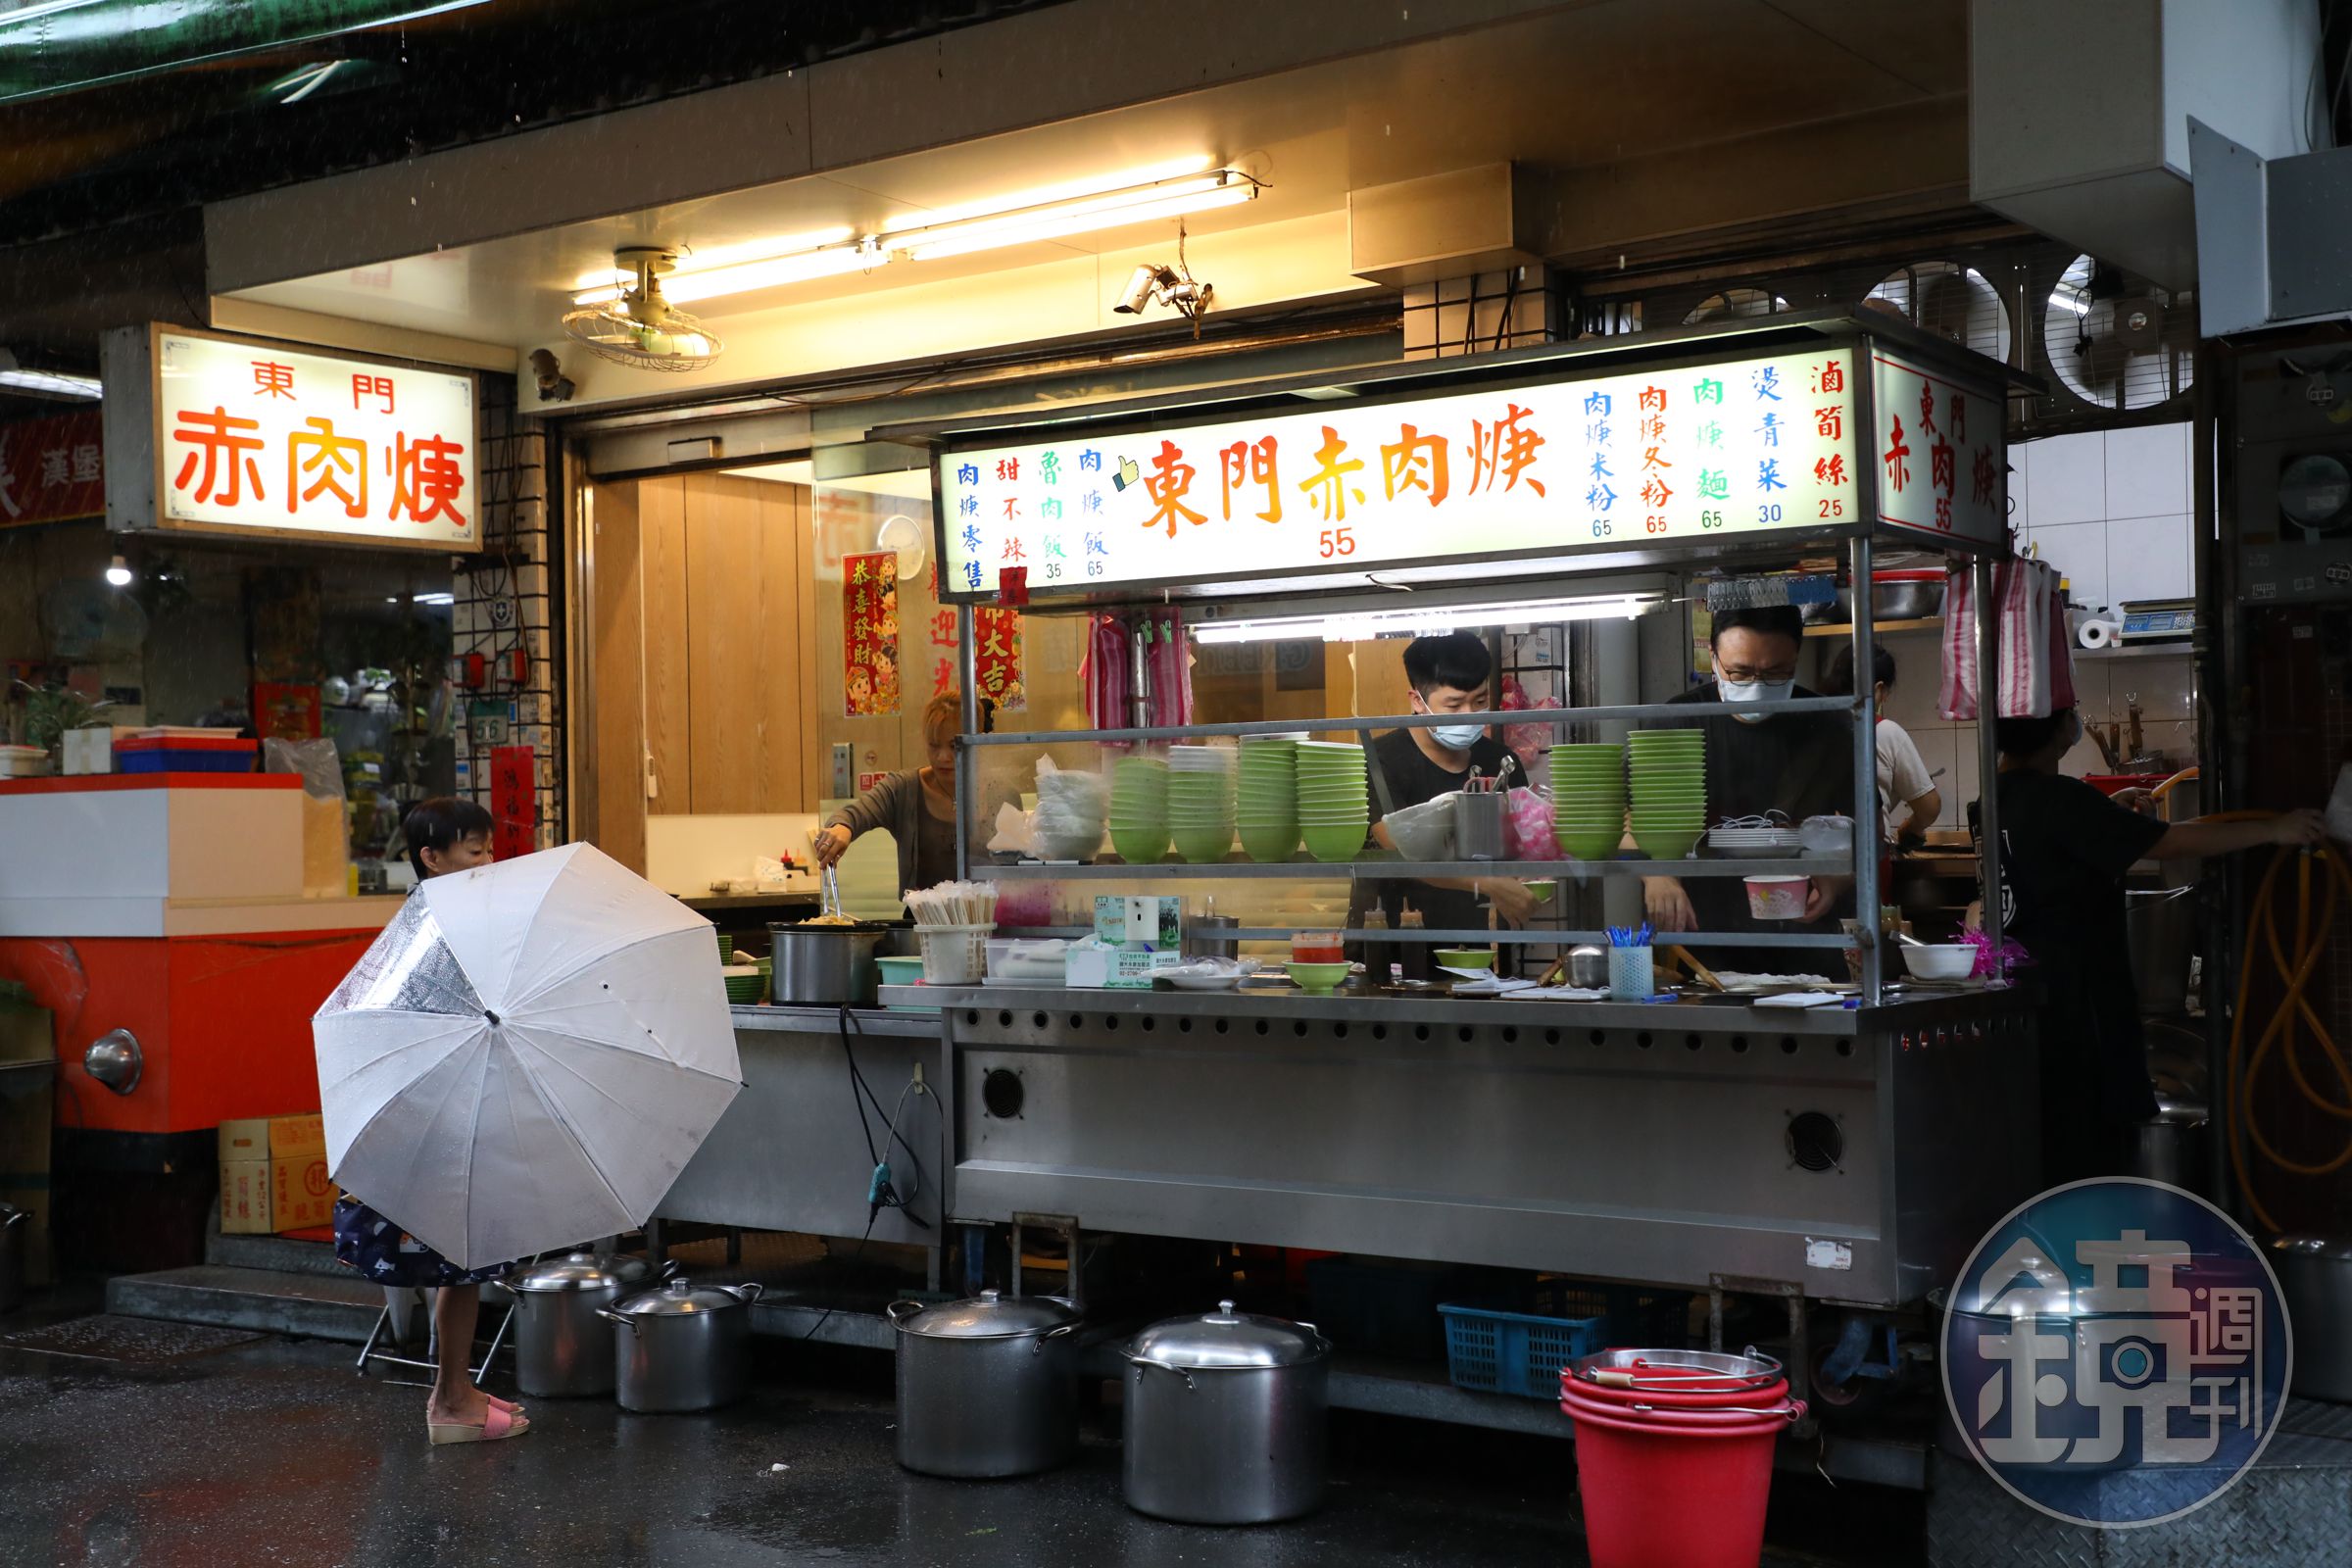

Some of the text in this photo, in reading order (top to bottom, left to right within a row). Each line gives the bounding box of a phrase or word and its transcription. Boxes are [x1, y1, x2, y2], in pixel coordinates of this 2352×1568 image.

[251, 360, 396, 416] 東門
[1918, 379, 1966, 446] 東門
[172, 405, 466, 527] 赤肉焿
[1141, 403, 1546, 540] 東門赤肉焿
[1751, 367, 1788, 523] 燙青菜 30
[1810, 360, 1850, 518] 滷筍絲 25
[996, 457, 1027, 563] 甜不辣
[1039, 451, 1067, 579] 魯肉飯 35
[1319, 526, 1357, 560] 55
[1592, 518, 1612, 537] 65
[1646, 514, 1667, 534] 65
[1701, 510, 1723, 529] 65
[1936, 498, 1952, 531] 55
[1087, 561, 1103, 577] 65
[852, 559, 873, 665] 恭喜發財
